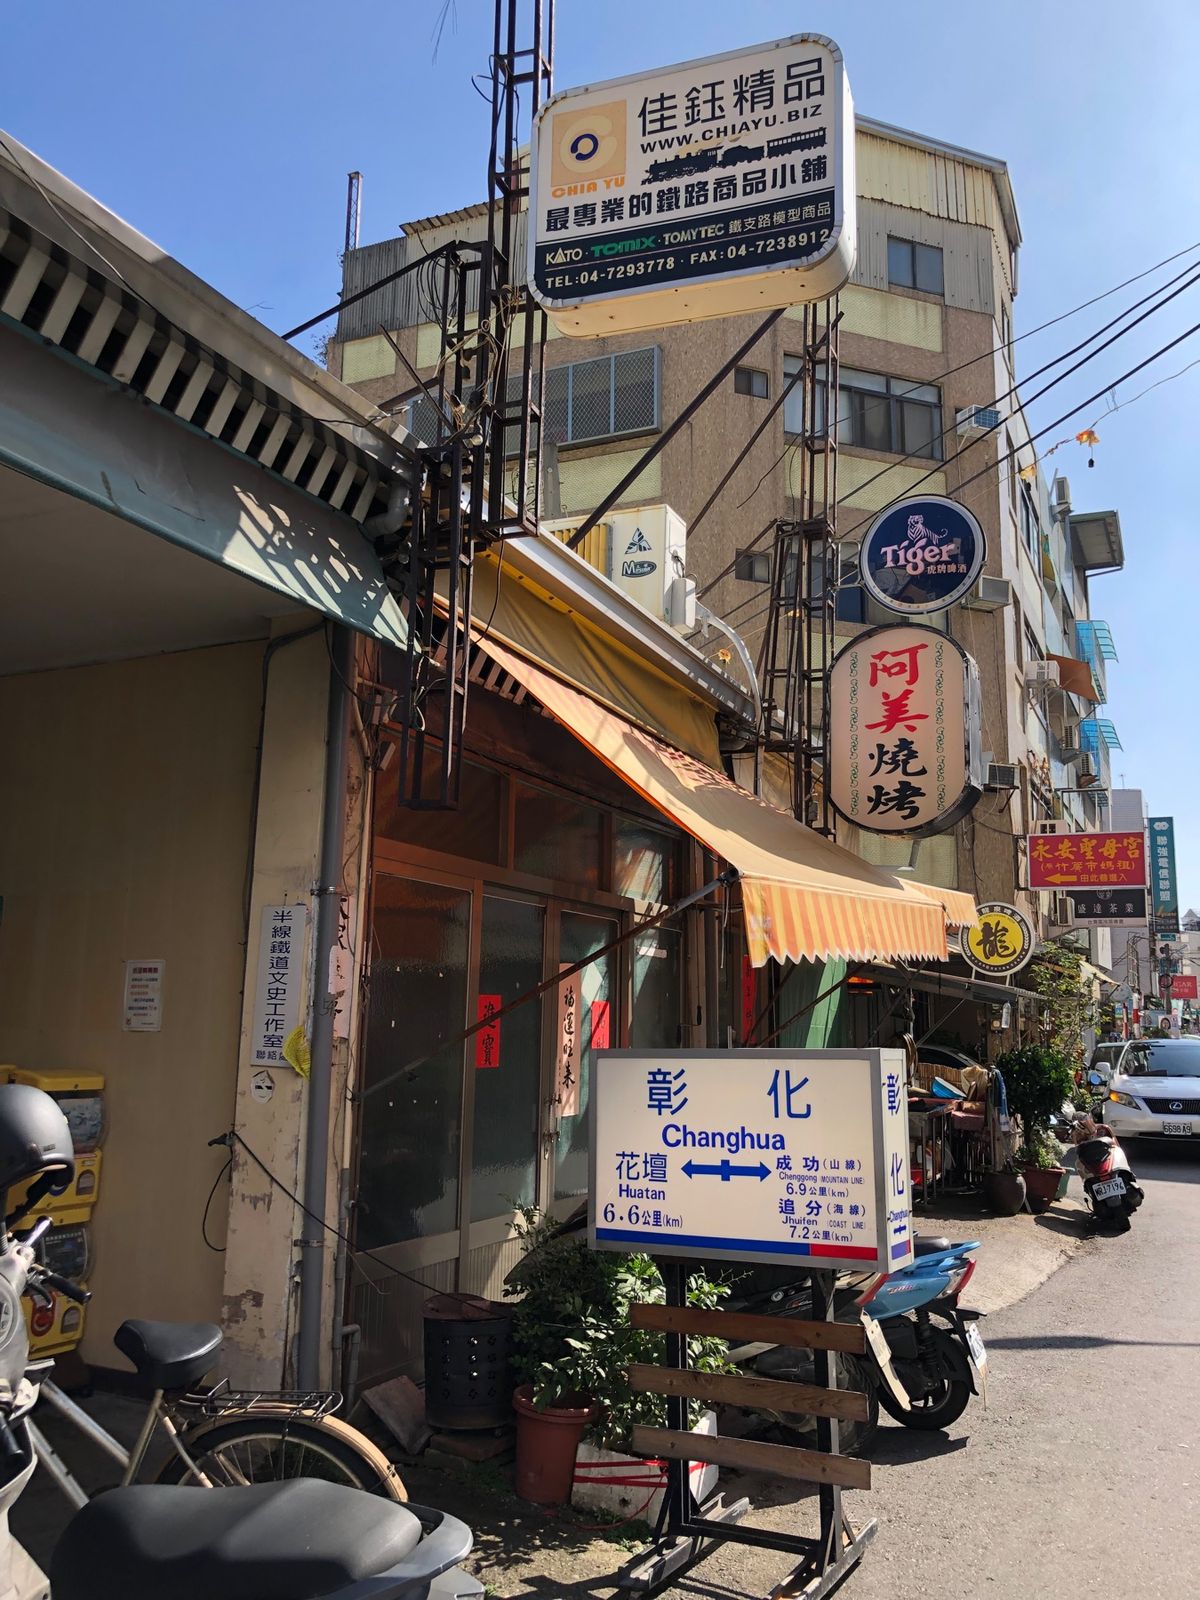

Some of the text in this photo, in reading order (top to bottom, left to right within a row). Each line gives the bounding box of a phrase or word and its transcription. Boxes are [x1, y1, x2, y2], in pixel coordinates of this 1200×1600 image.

[638, 57, 825, 137] 佳鈺精品
[640, 104, 823, 154] WWW.CHIAYU.BIZ
[551, 175, 625, 199] CHIA YU
[545, 201, 831, 265] KATO TOMIX TOMYTEC 鐵支路模型商品
[545, 228, 830, 289] TEL:04-7293778 FAX:04-7238912
[880, 538, 956, 576] Tiger
[927, 563, 967, 575] 虎牌啤酒
[865, 643, 929, 821] 阿美燒烤
[1031, 836, 1143, 862] 永安聖母宮
[976, 919, 1017, 960] 龍
[262, 909, 293, 1048] 半線鐵道文史工作室
[647, 1068, 812, 1119] 彰化
[661, 1123, 786, 1154] Changhua
[615, 1151, 668, 1183] 花壇
[778, 1171, 818, 1183] Chenggong
[618, 1183, 666, 1201] Huatan
[782, 1215, 818, 1226] Jhuifen
